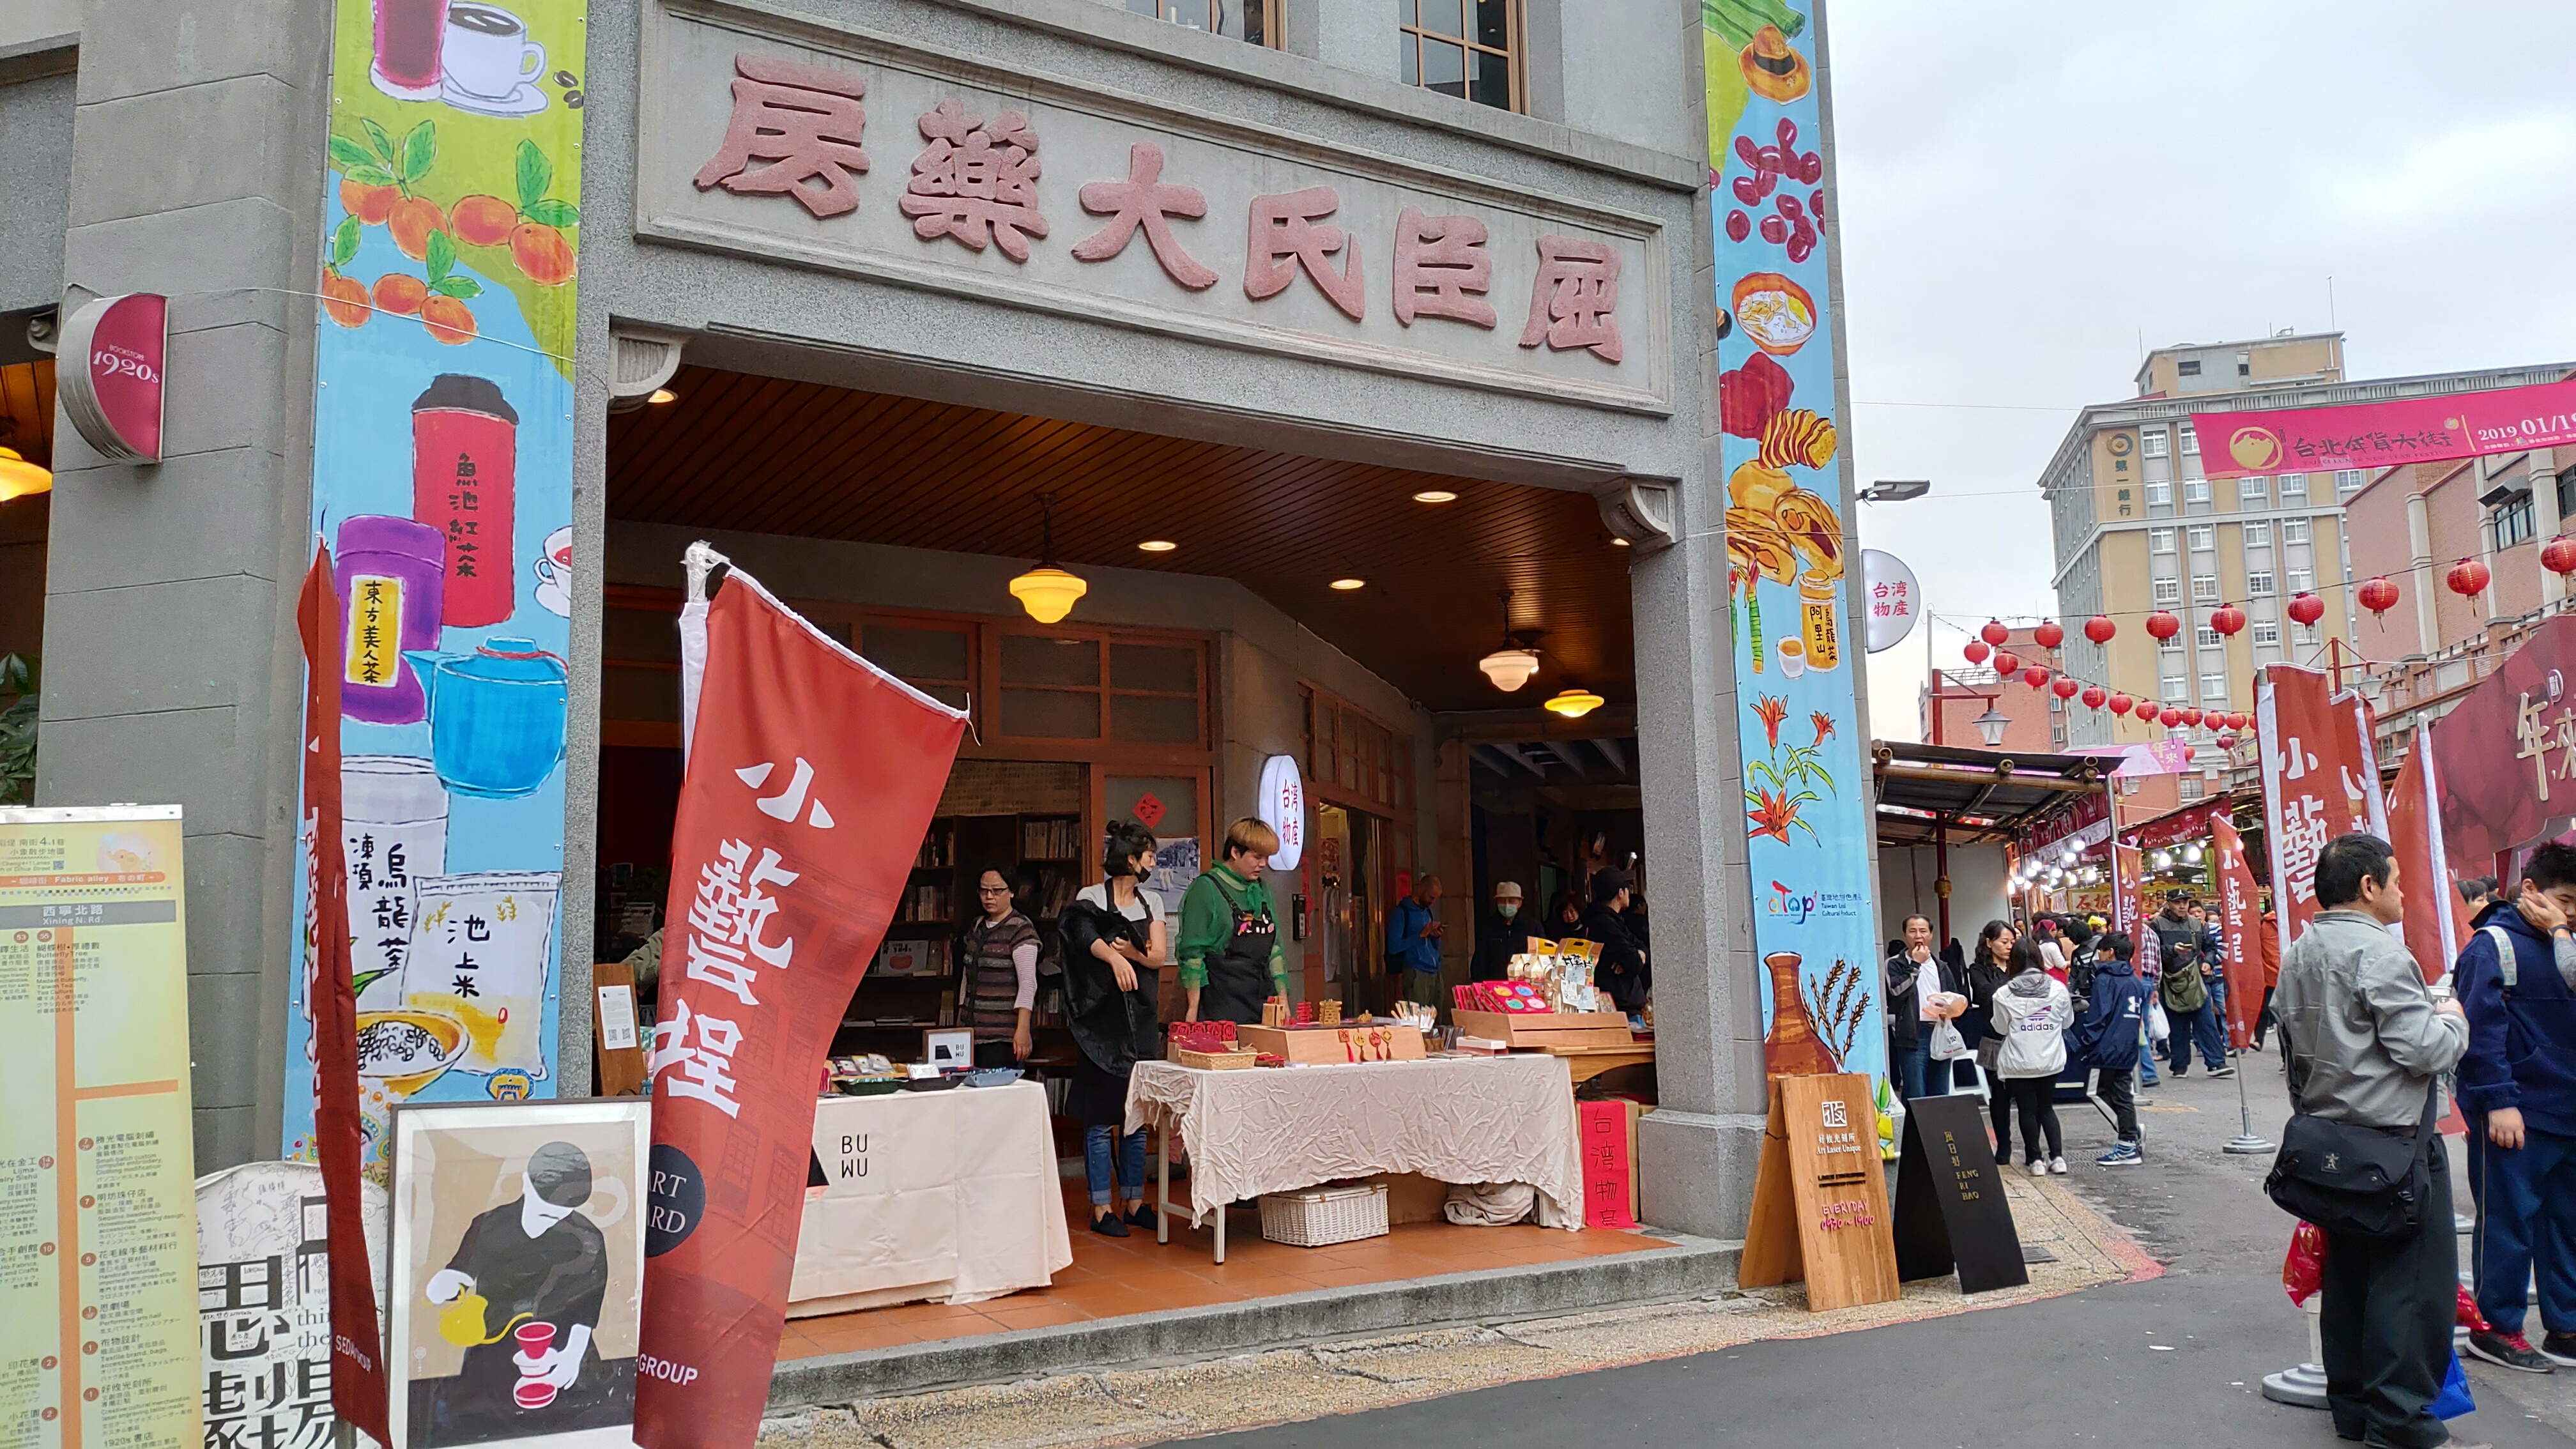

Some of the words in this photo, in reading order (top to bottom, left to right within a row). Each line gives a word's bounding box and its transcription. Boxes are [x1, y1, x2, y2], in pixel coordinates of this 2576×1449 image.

[93, 351, 160, 383] 1920s
[2293, 429, 2453, 457] 台北年貨大街
[2478, 425, 2517, 441] 2019
[2115, 459, 2131, 516] 第一銀行
[448, 452, 479, 577] 魚池紅茶
[363, 580, 383, 683] 東方美人茶
[1809, 605, 1825, 654] 阿里山
[43, 904, 103, 917] 西寧北路
[43, 917, 73, 925] Xining
[447, 914, 490, 998] 池上米
[2021, 1023, 2054, 1031] adidas
[841, 1133, 868, 1154] BU
[1827, 1144, 1841, 1153] Laser
[1843, 1144, 1861, 1154] Unique
[841, 1157, 868, 1179] WU
[648, 1170, 687, 1199] RT
[1822, 1200, 1869, 1215] EVERYDAY
[1821, 1216, 1843, 1232] 0930
[1854, 1215, 1875, 1228] 1900
[639, 1353, 698, 1386] GROUP
